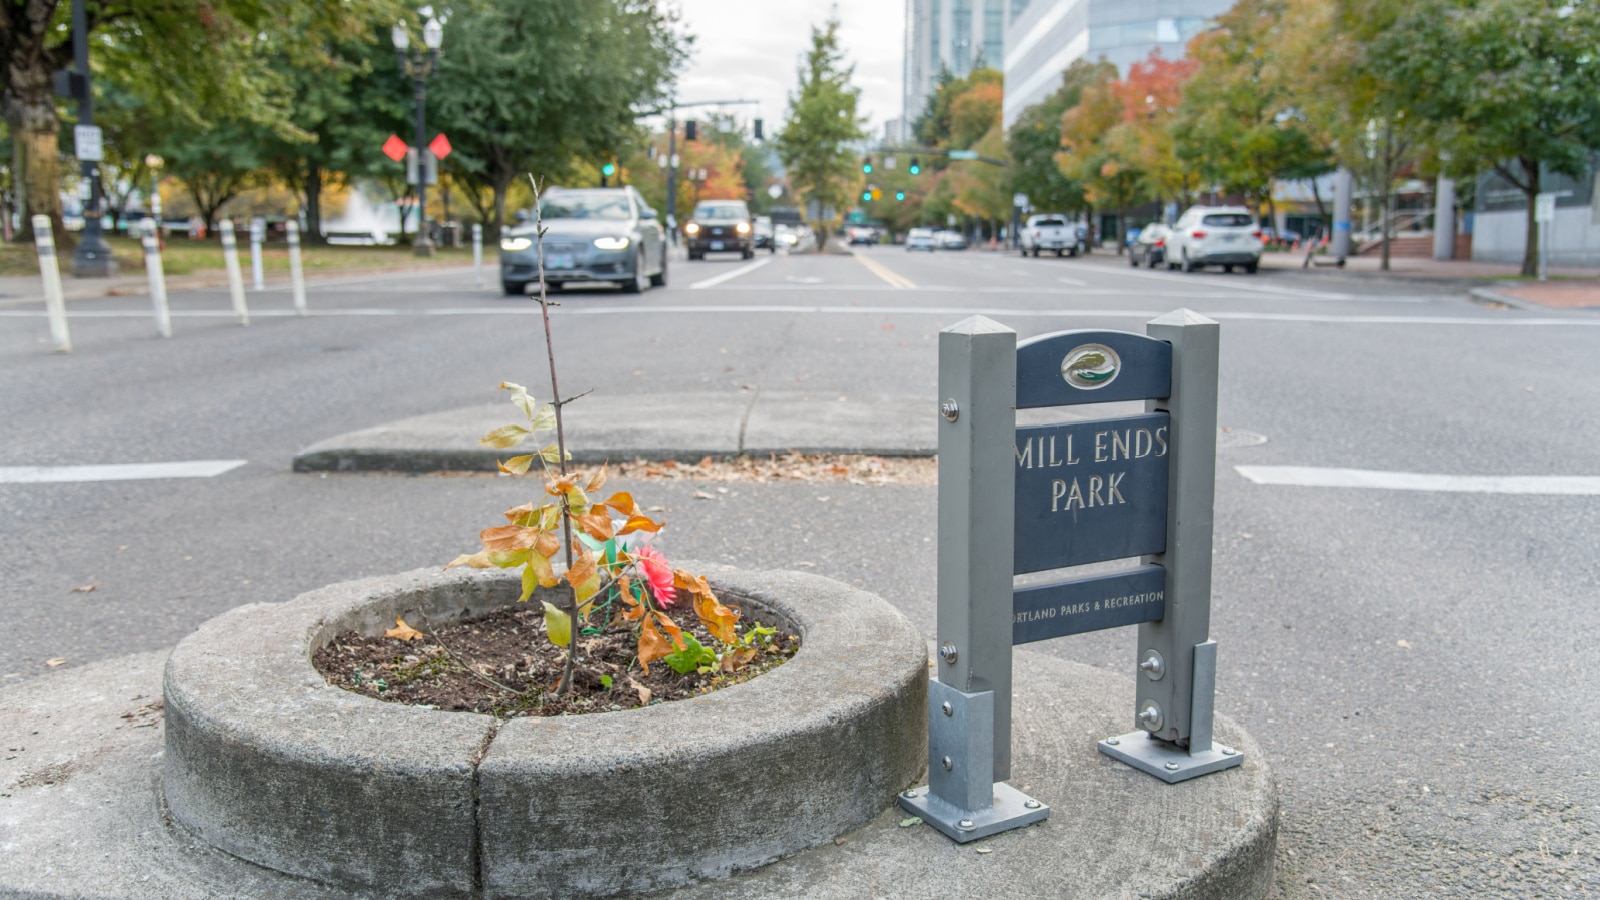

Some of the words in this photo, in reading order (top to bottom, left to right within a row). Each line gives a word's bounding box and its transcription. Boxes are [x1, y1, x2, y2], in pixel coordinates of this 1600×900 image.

[1013, 433, 1080, 469] MILL
[1094, 425, 1168, 463] ENDS
[1051, 471, 1127, 512] PARK
[1012, 607, 1057, 624] RTLAND
[1060, 602, 1090, 616] PARKS
[1094, 601, 1101, 611] &
[1104, 590, 1165, 609] RECREATION
